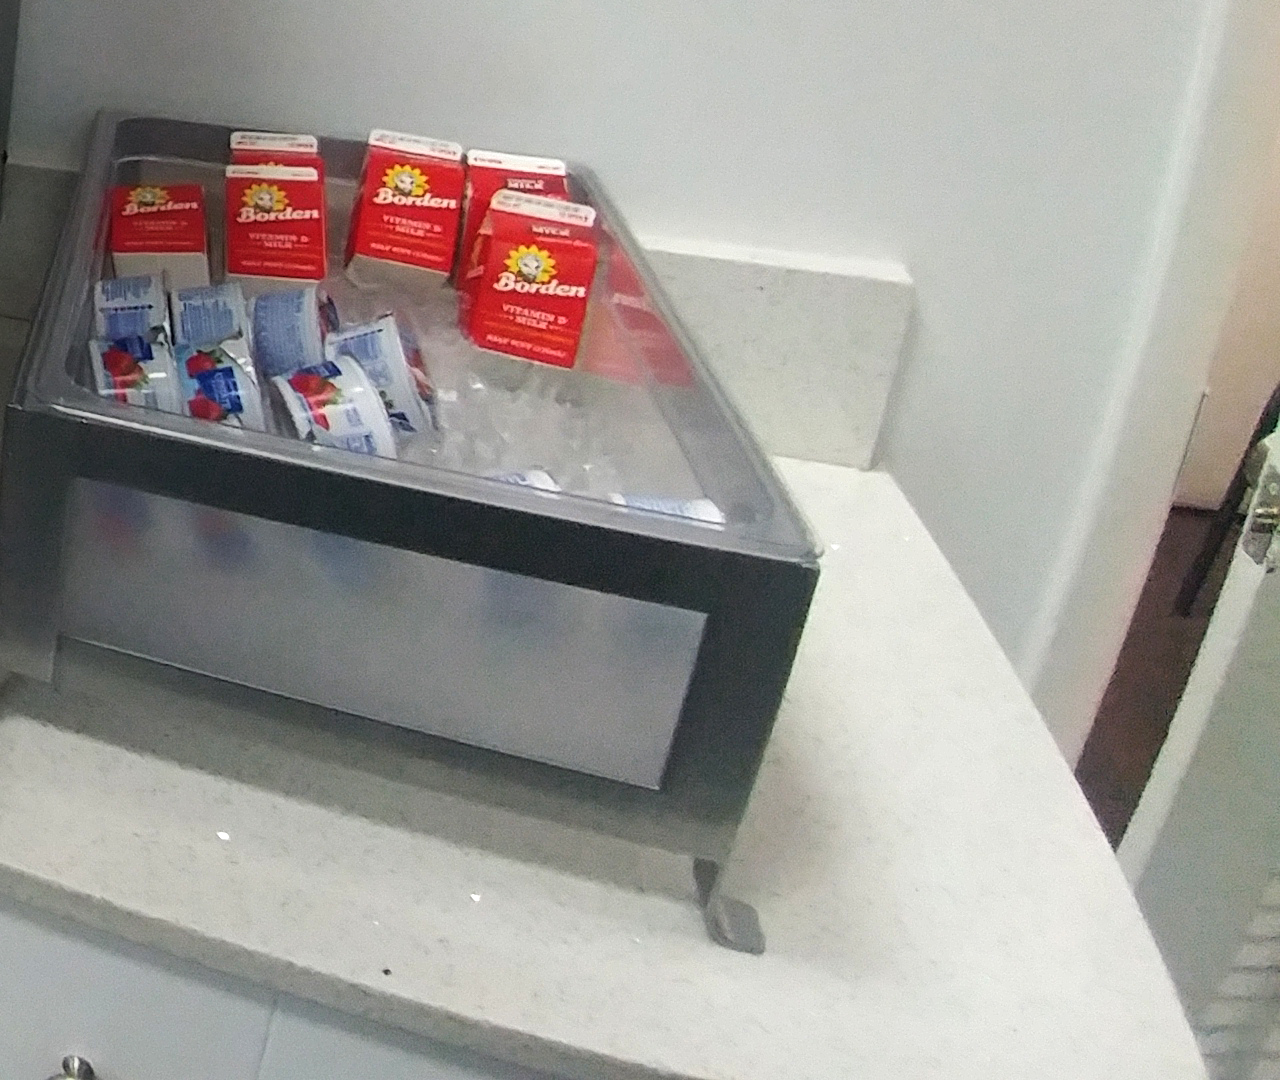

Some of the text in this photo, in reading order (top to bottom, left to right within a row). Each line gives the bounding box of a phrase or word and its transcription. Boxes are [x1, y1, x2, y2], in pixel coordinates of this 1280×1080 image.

[121, 200, 200, 216] Borden
[372, 187, 458, 210] Borden
[236, 206, 320, 224] Borden
[492, 270, 587, 299] Borden
